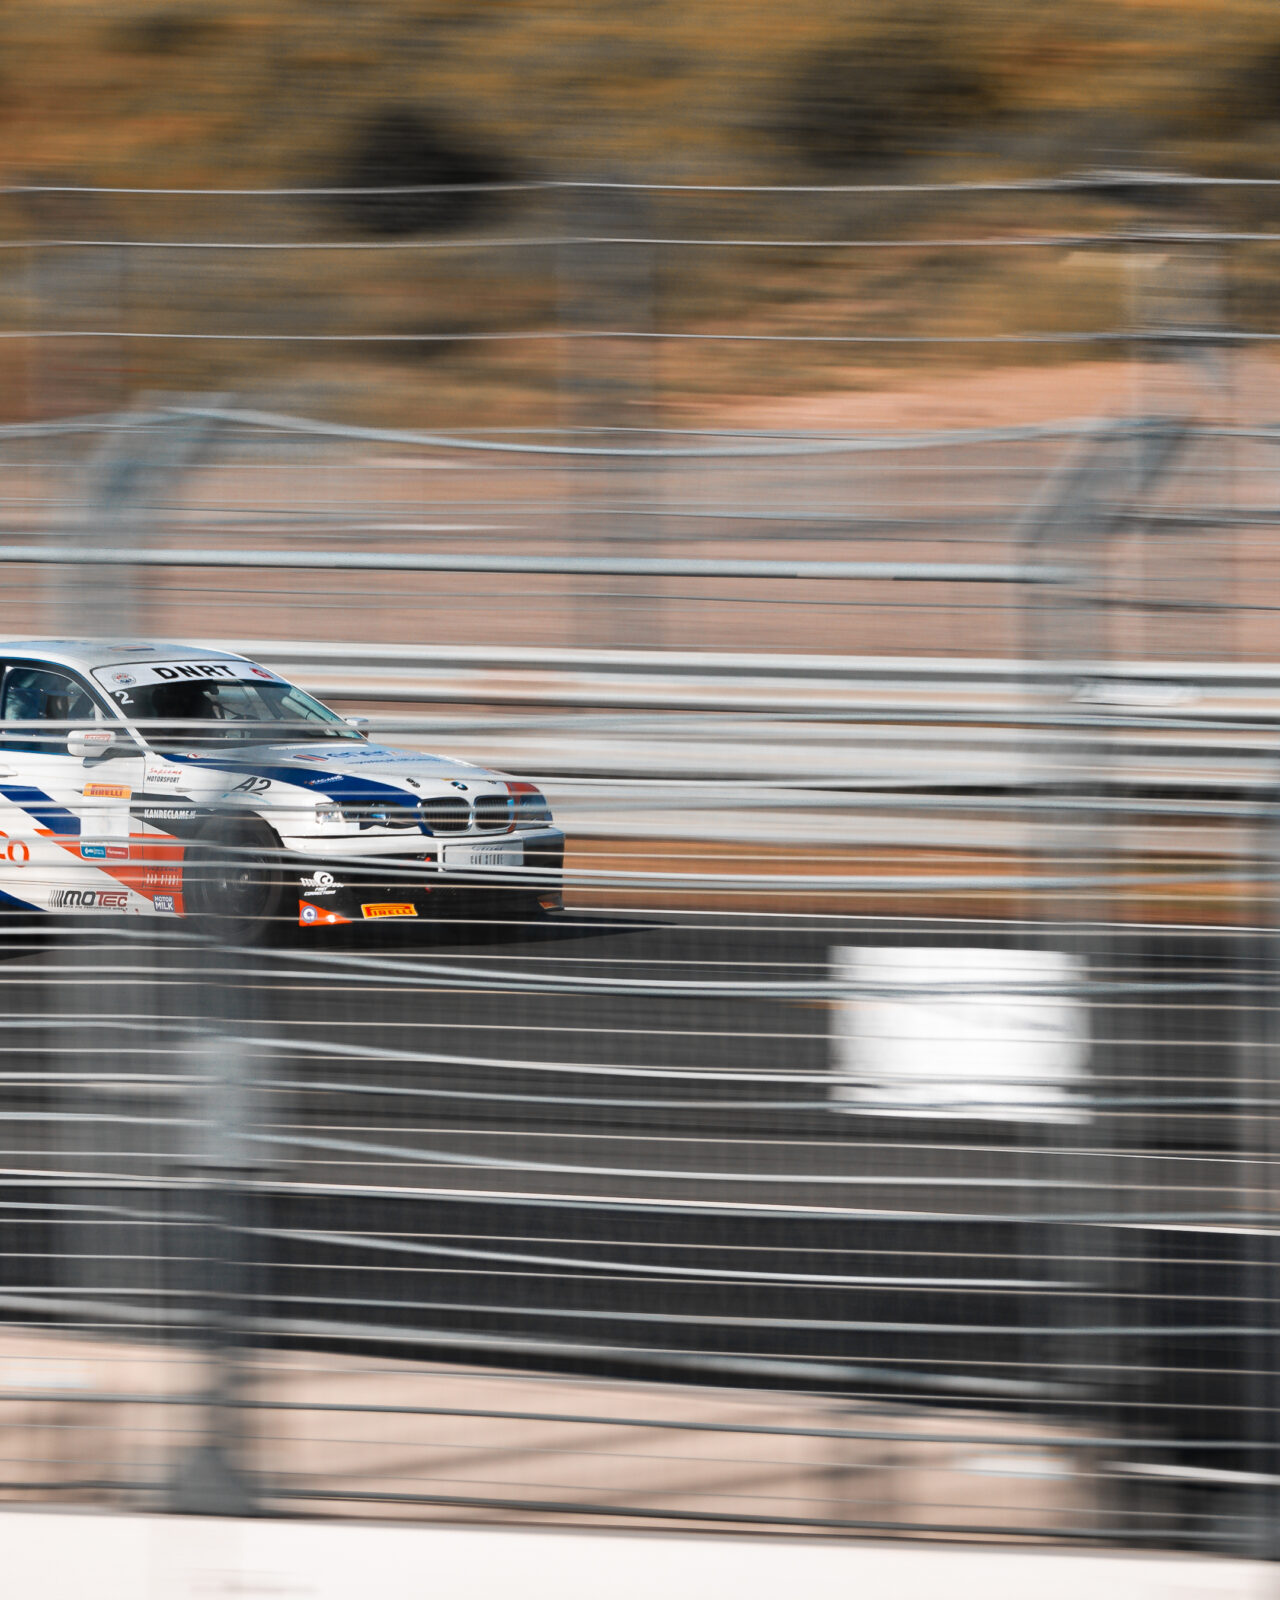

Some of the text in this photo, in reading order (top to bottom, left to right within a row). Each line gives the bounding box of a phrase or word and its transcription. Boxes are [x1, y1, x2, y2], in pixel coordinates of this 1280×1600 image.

[152, 664, 238, 680] DNRT
[115, 690, 134, 705] 2
[233, 776, 272, 796] A2
[154, 901, 174, 911] MILK
[364, 905, 414, 918] PIRELLI
